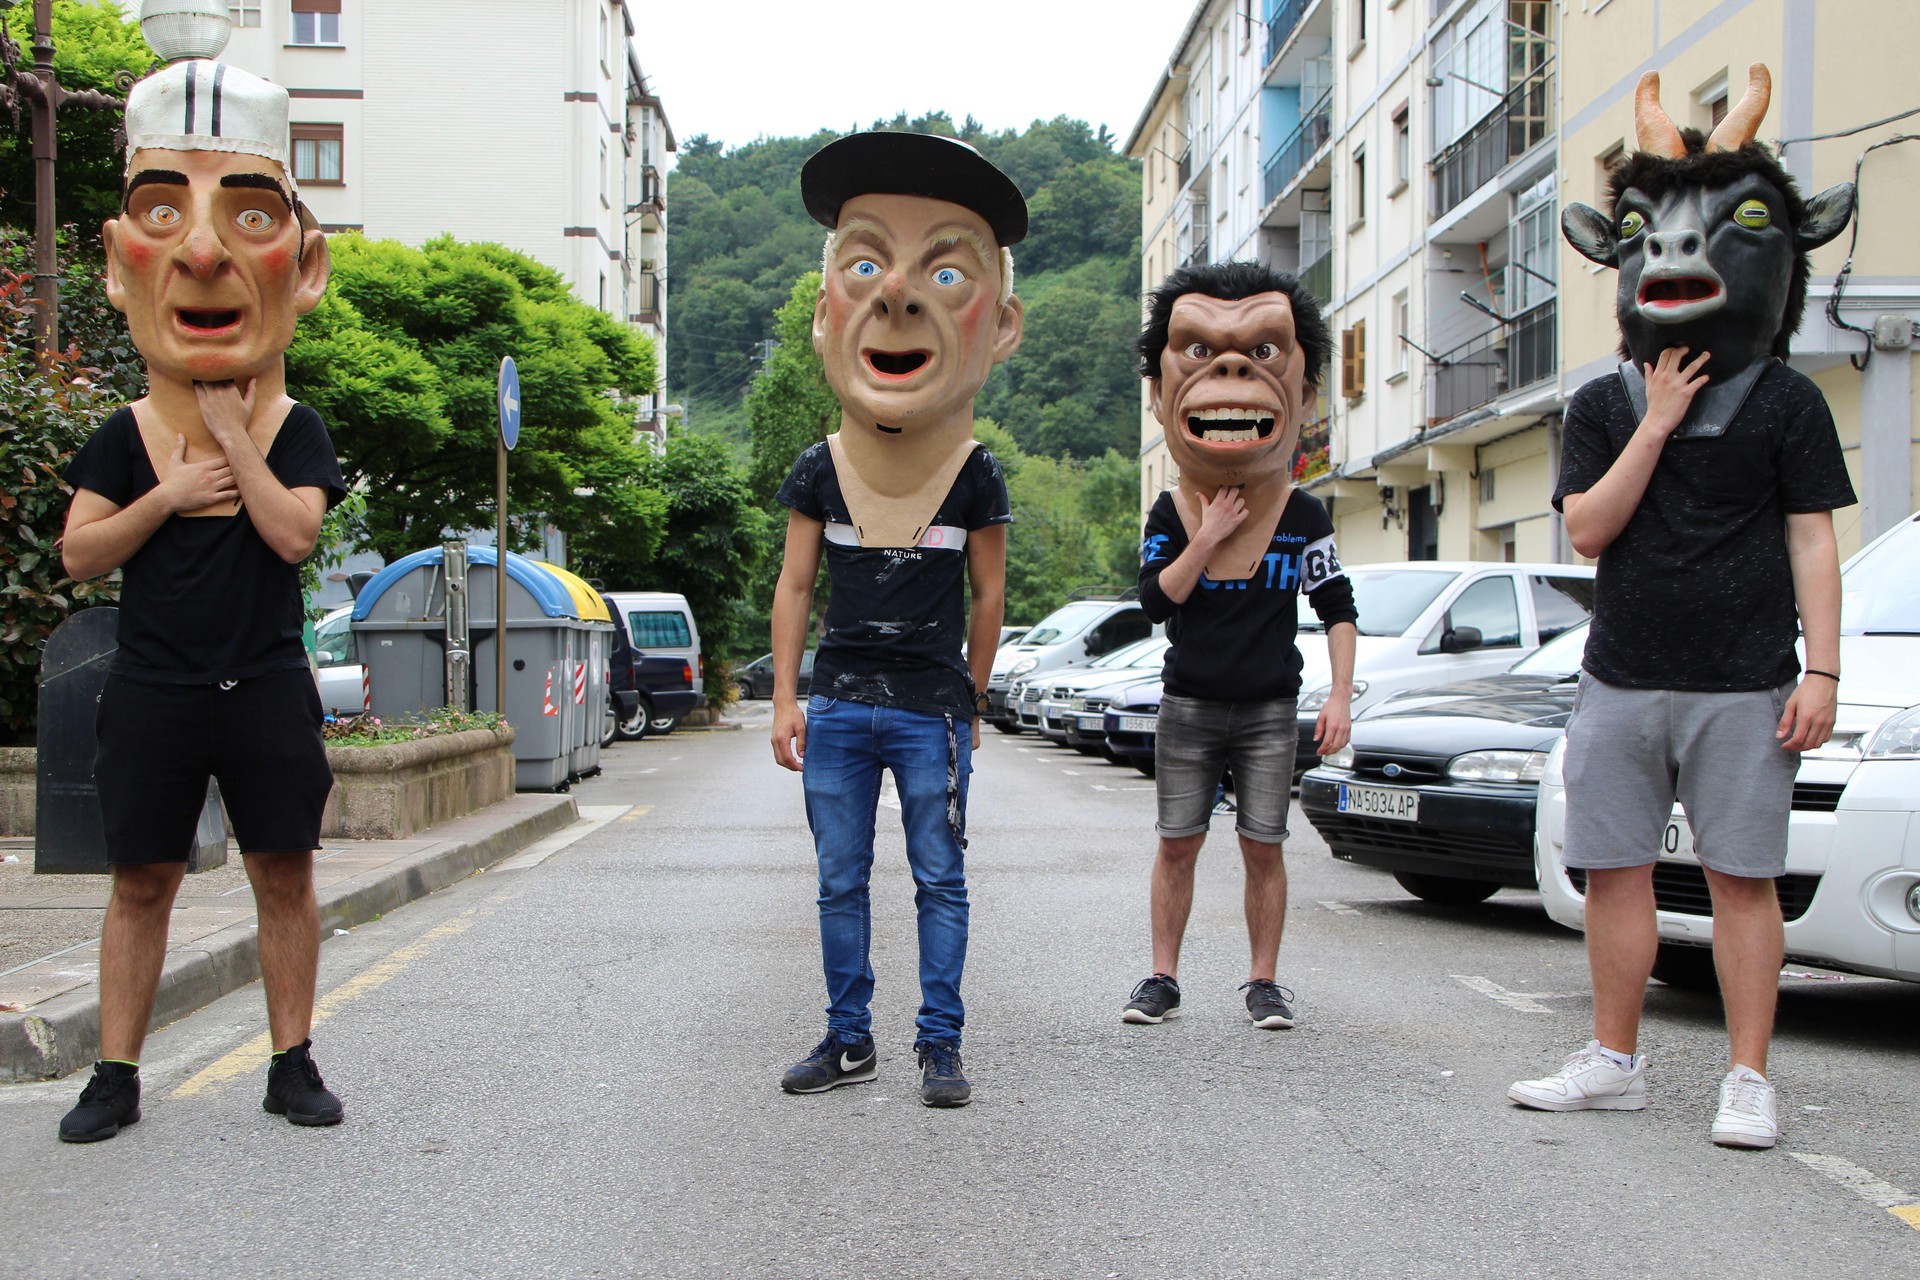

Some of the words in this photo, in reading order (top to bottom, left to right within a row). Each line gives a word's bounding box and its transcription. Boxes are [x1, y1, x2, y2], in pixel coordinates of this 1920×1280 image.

[919, 527, 945, 547] D
[1272, 532, 1307, 543] roblems
[883, 549, 922, 560] NATURE
[1145, 720, 1158, 731] CC
